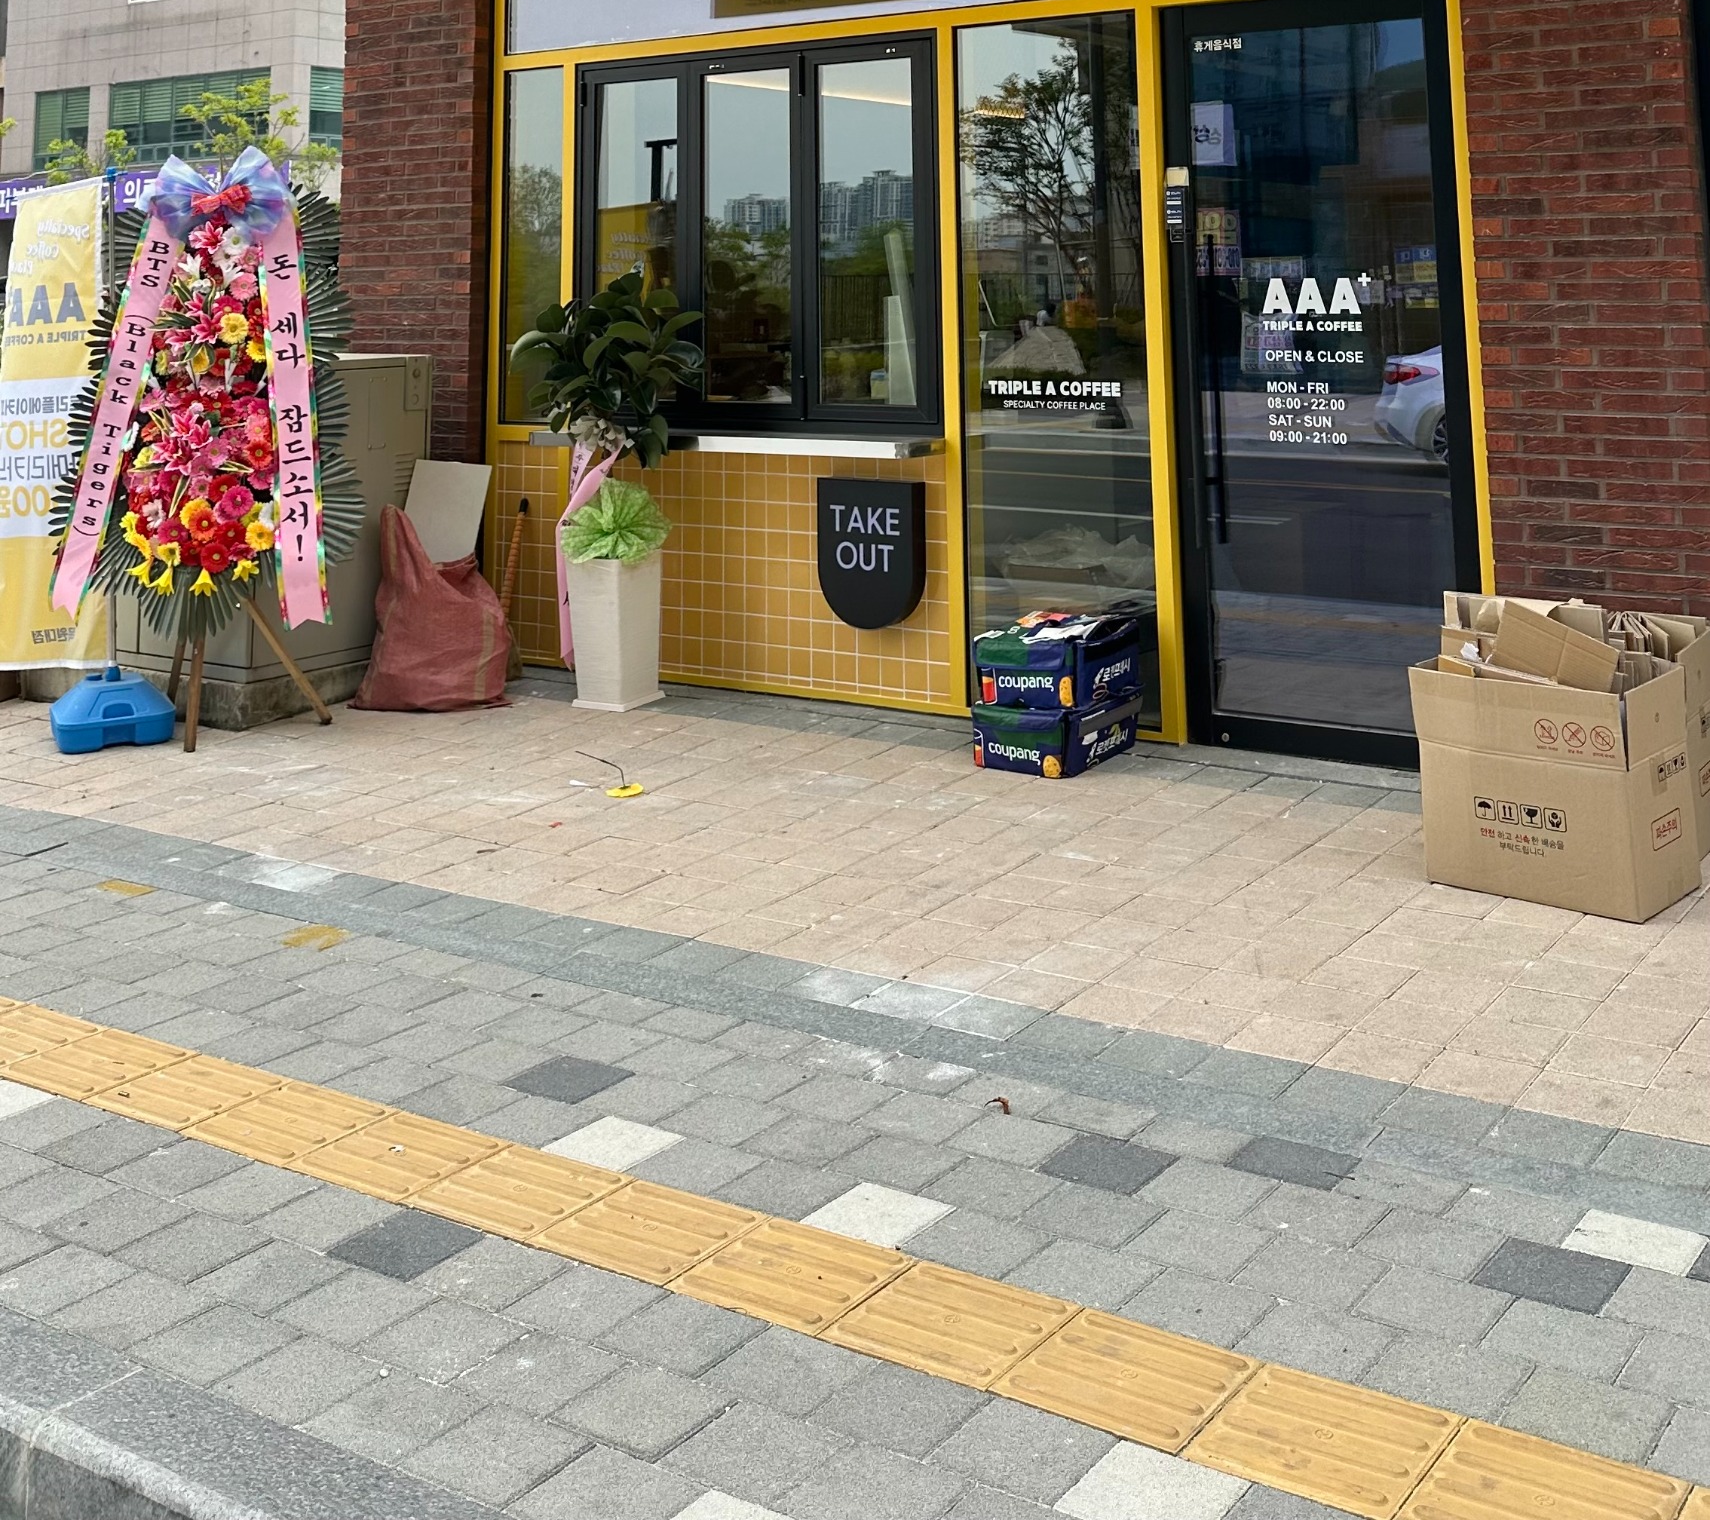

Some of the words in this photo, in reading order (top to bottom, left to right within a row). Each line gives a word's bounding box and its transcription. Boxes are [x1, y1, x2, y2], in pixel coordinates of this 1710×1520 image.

[1193, 37, 1242, 53] 휴게음식점
[140, 239, 171, 289] BTS
[267, 253, 298, 281] 돈
[1262, 320, 1304, 332] TRIPLE
[1305, 321, 1315, 332] A
[1316, 321, 1363, 332] COFFEE
[1265, 350, 1302, 363] OPEN
[1304, 350, 1315, 363] &
[1317, 350, 1365, 364] CLOSE
[987, 380, 1042, 396] TRIPLE
[1045, 381, 1057, 396] A
[1059, 381, 1122, 397] COFFEE
[1266, 381, 1298, 394] MON
[1307, 382, 1330, 395] FRI
[1003, 399, 1046, 410] SPECIALTY
[1046, 400, 1078, 410] COFFEE
[1079, 401, 1106, 411] PLACE
[1267, 397, 1301, 410] 08:00
[1310, 398, 1346, 411] 22:00
[1268, 414, 1295, 427] SAT
[1303, 415, 1332, 428] SUN
[1269, 430, 1303, 443] 09:00
[1312, 431, 1348, 445] 21:00
[829, 504, 901, 536] TAKE
[836, 541, 895, 573] OUT
[998, 675, 1055, 692] coupang
[988, 740, 1041, 766] coupang
